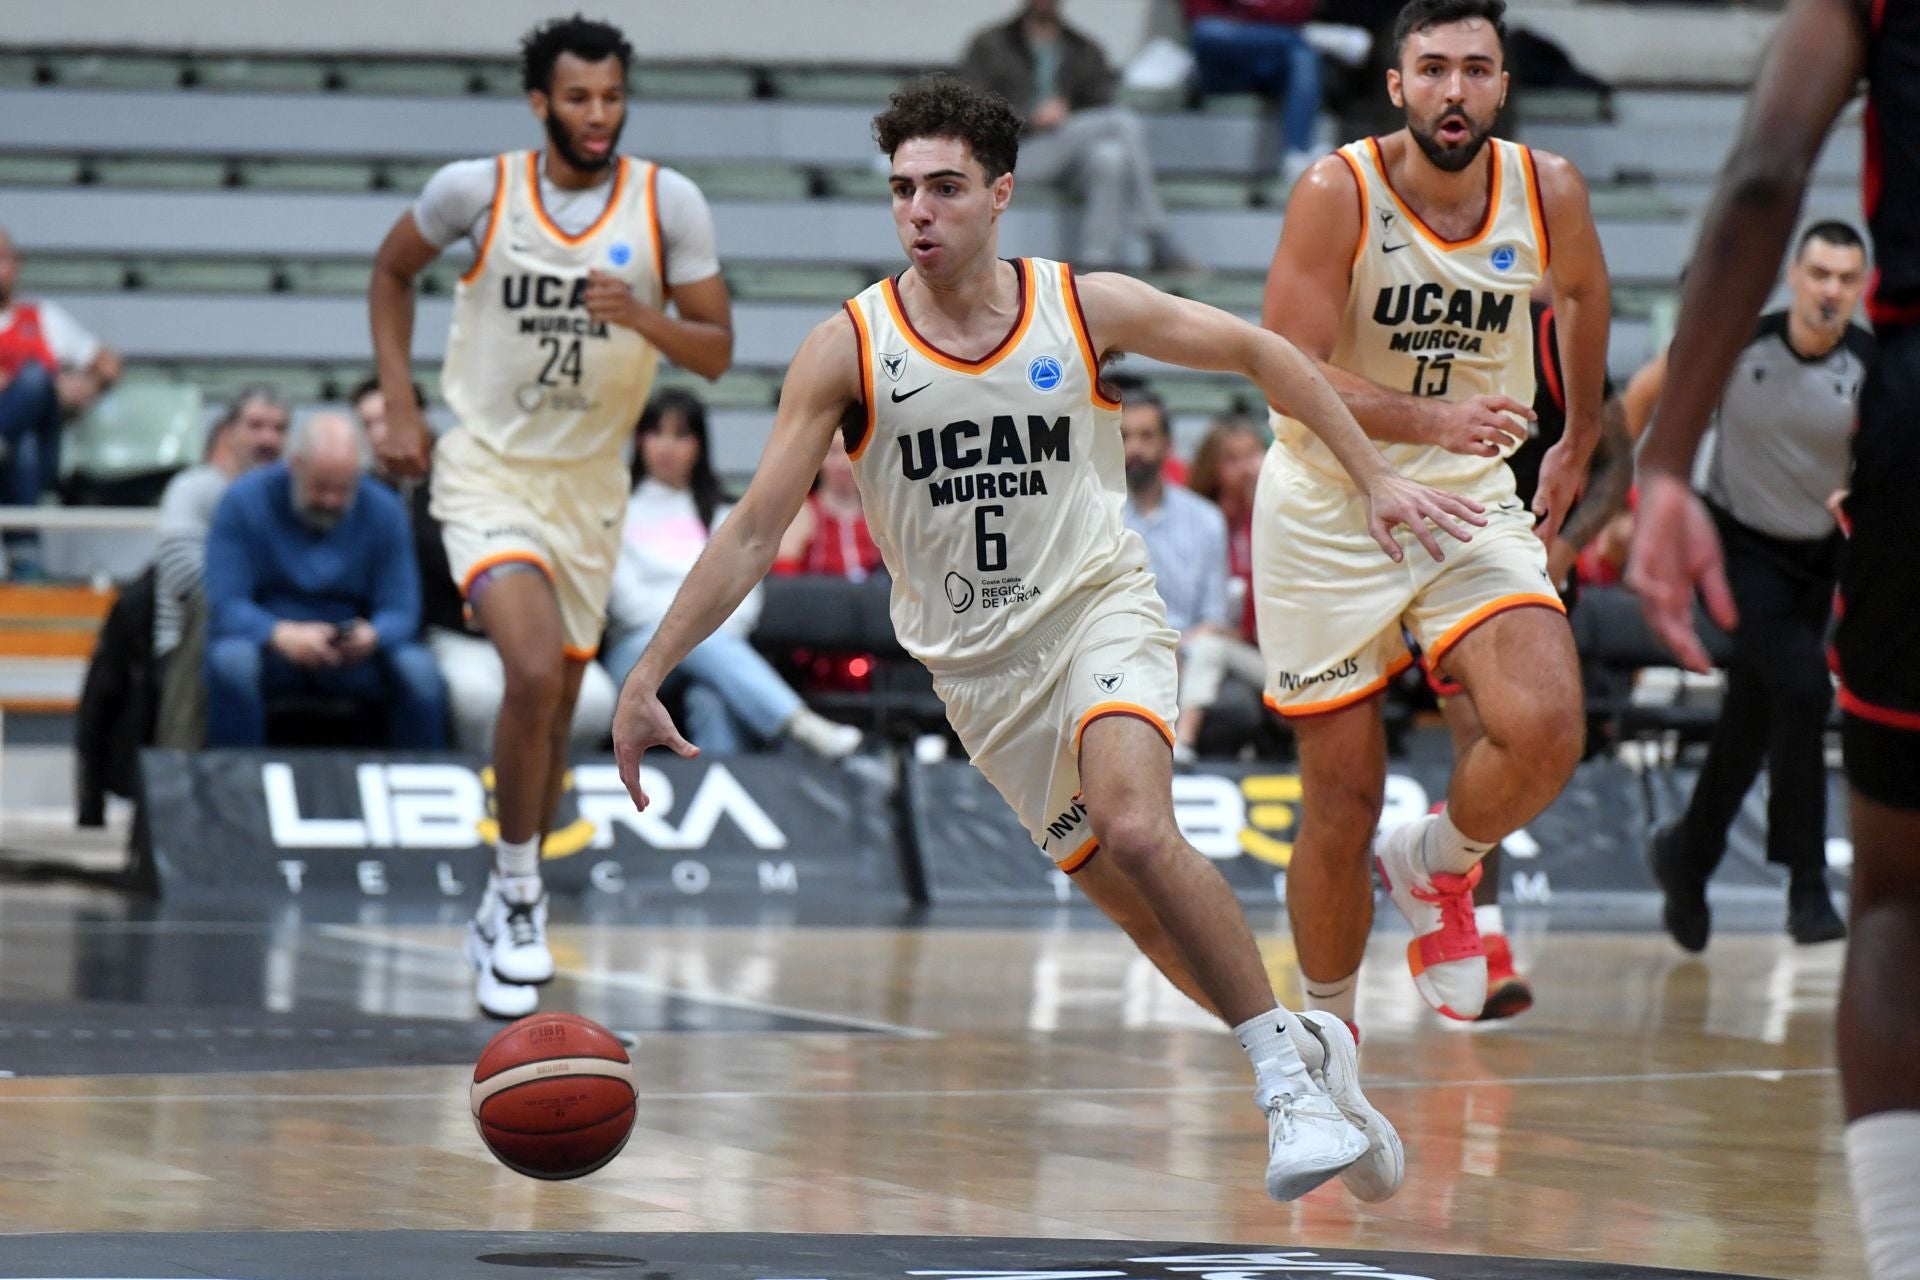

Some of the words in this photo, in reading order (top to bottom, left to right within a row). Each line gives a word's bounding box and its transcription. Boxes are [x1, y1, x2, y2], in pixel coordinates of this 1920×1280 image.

[503, 274, 590, 311] UCA
[1373, 283, 1514, 333] UCAM
[537, 337, 582, 386] 24
[1389, 330, 1482, 353] MURCIA
[1412, 353, 1455, 396] 15
[897, 415, 1070, 481] UCAM
[929, 470, 1048, 507] MURCIA
[975, 505, 1008, 572] 6
[982, 598, 999, 608] DE
[277, 860, 798, 895] TELCOM
